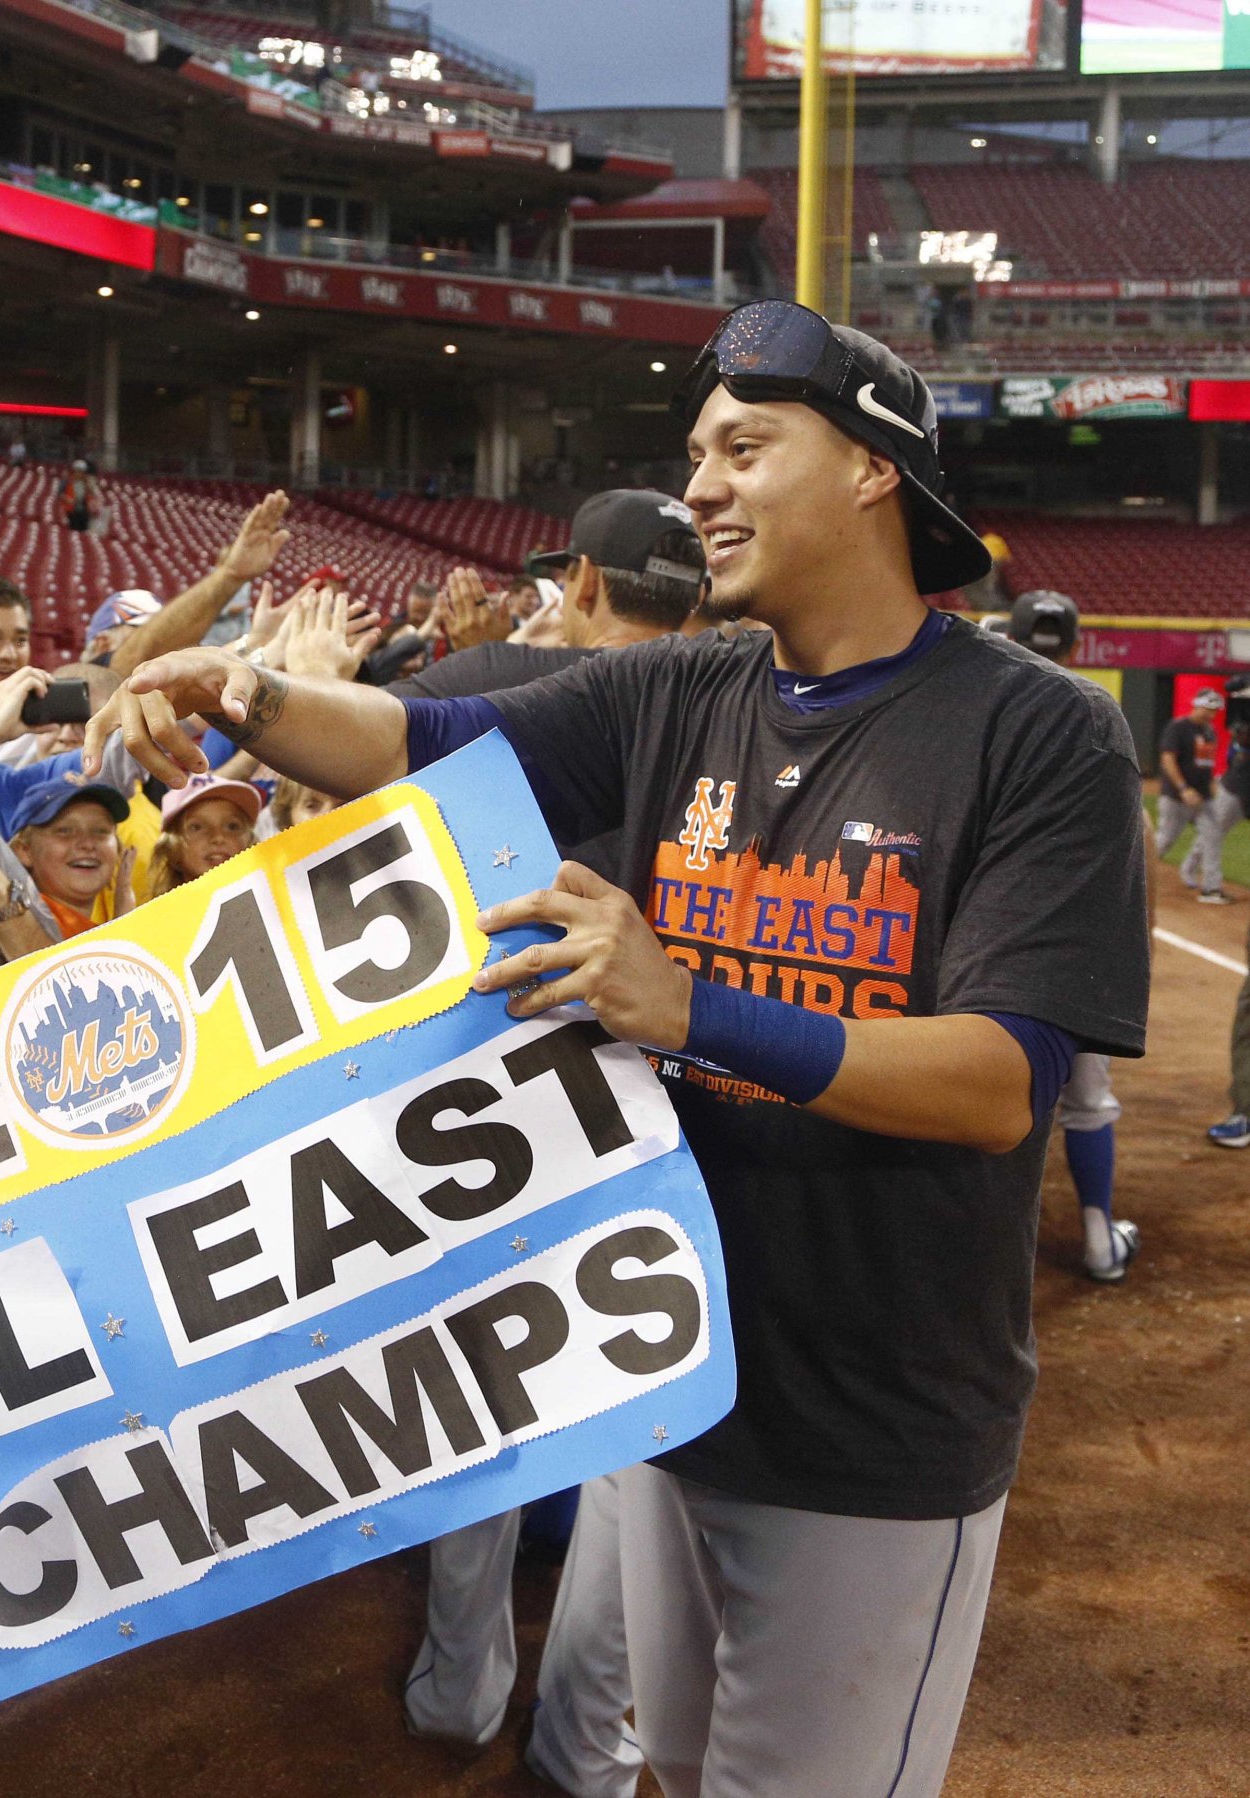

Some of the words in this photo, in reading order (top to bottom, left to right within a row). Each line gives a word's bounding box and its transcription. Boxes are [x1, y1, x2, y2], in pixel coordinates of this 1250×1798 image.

[679, 777, 737, 870] NY
[865, 827, 923, 847] Authentic
[747, 895, 911, 967] EAST
[46, 1006, 160, 1103] Mets
[662, 1059, 681, 1079] NL
[145, 1012, 634, 1343] EAST
